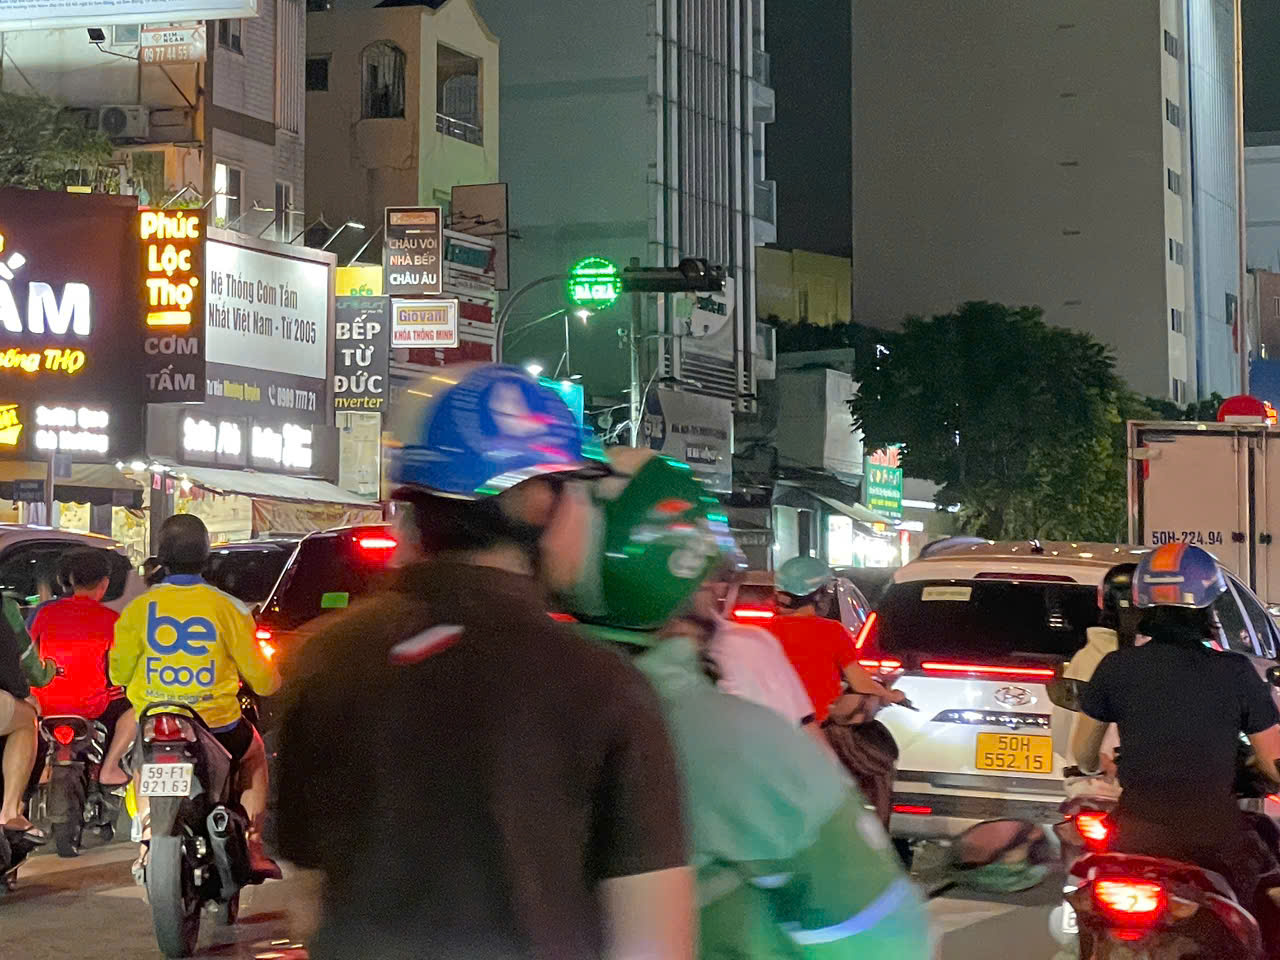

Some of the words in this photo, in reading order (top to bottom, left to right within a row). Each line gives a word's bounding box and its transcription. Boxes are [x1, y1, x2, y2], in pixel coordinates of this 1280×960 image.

[140, 211, 200, 240] Phúc
[388, 238, 418, 252] CHẬU
[148, 244, 192, 277] Lộc
[389, 252, 412, 266] NHÀ
[414, 252, 436, 266] BẾP
[389, 271, 419, 285] CHÂU
[420, 271, 438, 285] ÂU
[210, 270, 223, 300] Hệ
[225, 271, 255, 304] Thống
[279, 281, 298, 310] Tấm
[208, 300, 230, 329] Nhất
[232, 306, 251, 337] Việt
[252, 311, 273, 337] Nam
[294, 319, 316, 344] 2005
[335, 313, 382, 340] BẾP
[144, 334, 199, 355] CƠM
[435, 329, 454, 341] MINH
[44, 348, 86, 374] THỌ
[341, 344, 375, 366] TỪ
[146, 365, 196, 391] TẤM
[334, 370, 383, 393] ĐỨC
[308, 391, 316, 412] 21
[334, 396, 384, 409] nverter
[1151, 530, 1223, 545] 50H-224.94
[146, 600, 217, 657] be
[146, 656, 216, 687] Food
[998, 736, 1031, 752] 50H
[984, 752, 1043, 770] 552.15
[148, 767, 184, 779] 59-F1
[142, 780, 189, 793] 921.63
